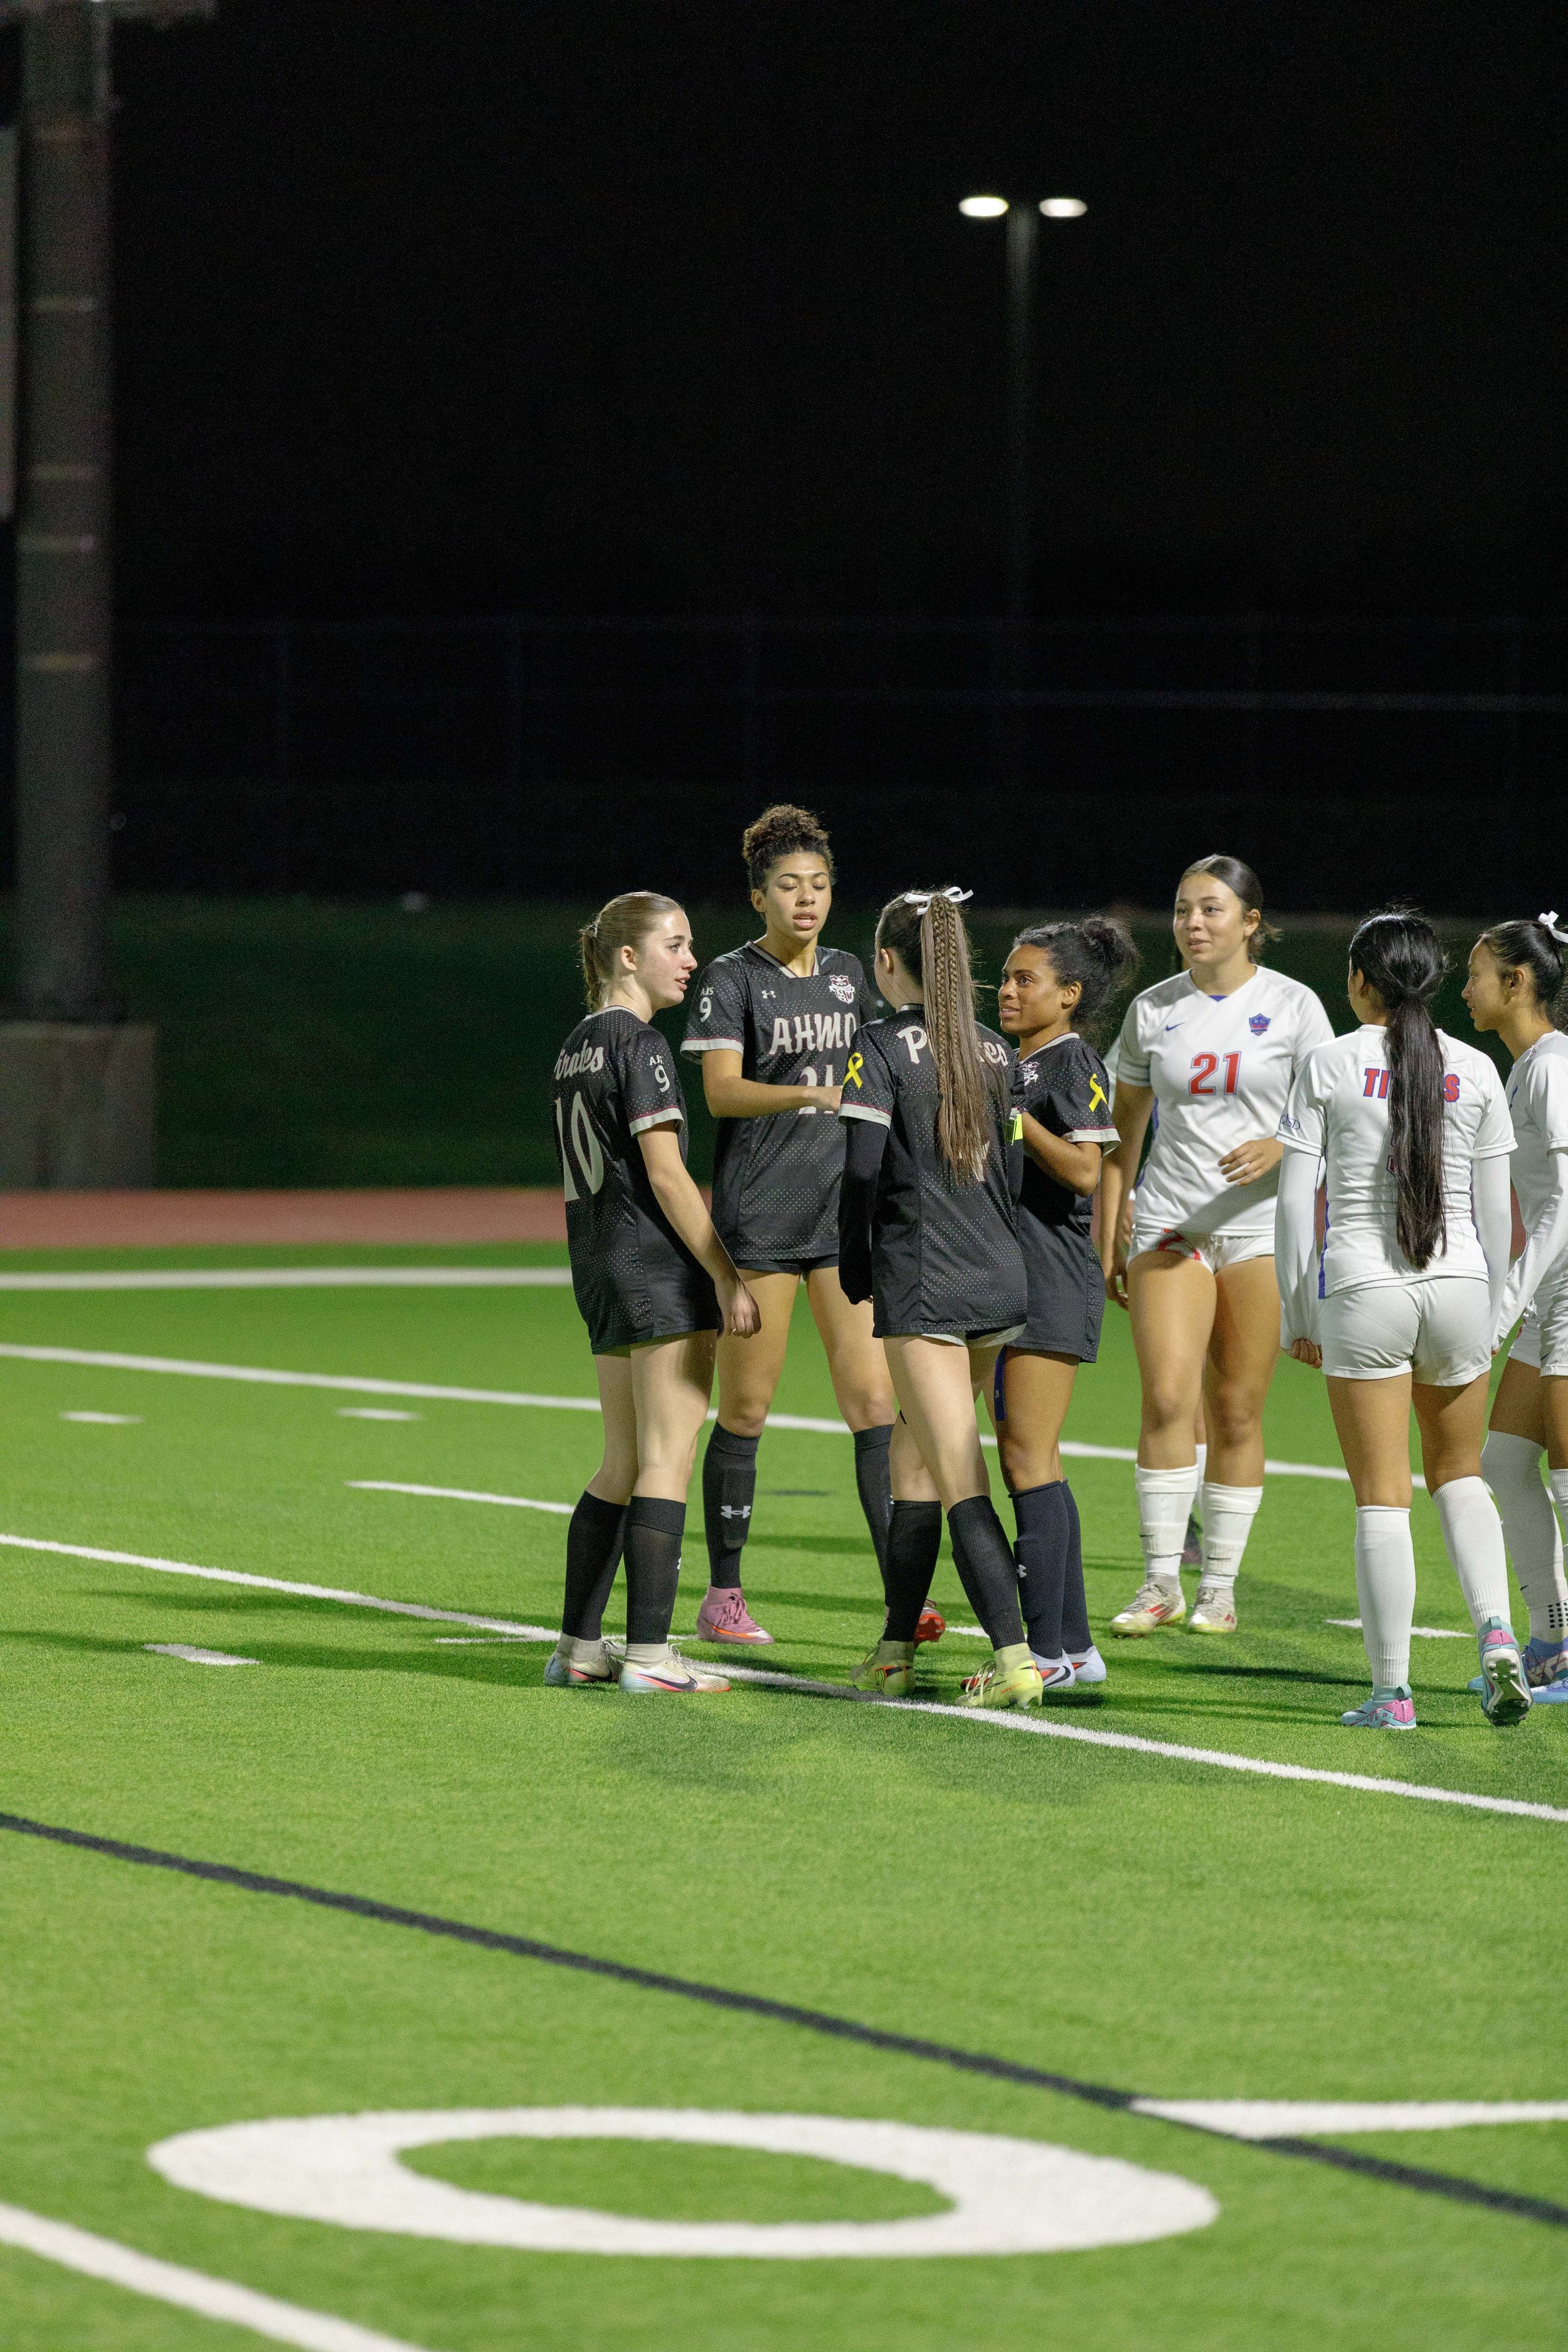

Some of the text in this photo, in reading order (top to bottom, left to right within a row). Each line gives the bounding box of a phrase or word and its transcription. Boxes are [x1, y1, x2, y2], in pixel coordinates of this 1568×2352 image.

[700, 987, 714, 996] AJS
[699, 997, 712, 1022] 9
[655, 1065, 670, 1093] 9
[1189, 1051, 1242, 1096] 21
[1362, 1067, 1461, 1103] TIS
[1279, 1113, 1300, 1130] GISD
